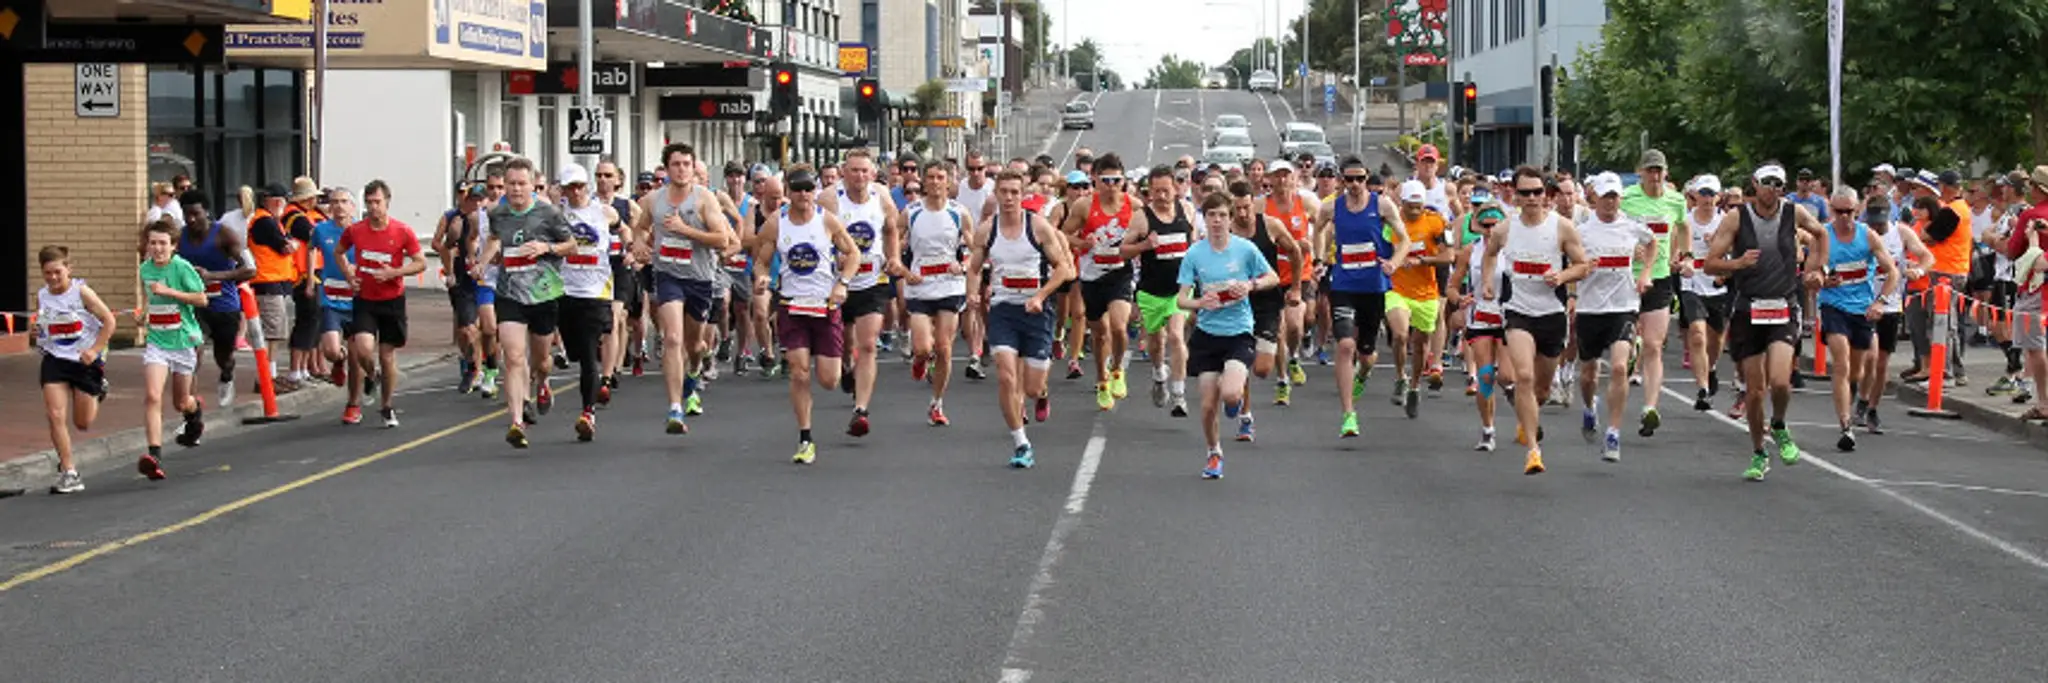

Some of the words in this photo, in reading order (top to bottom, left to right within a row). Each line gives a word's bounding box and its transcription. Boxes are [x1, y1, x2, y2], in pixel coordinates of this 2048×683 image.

[237, 33, 312, 47] Practising
[81, 64, 114, 78] ONE
[80, 82, 114, 96] WAY
[720, 100, 751, 114] nab
